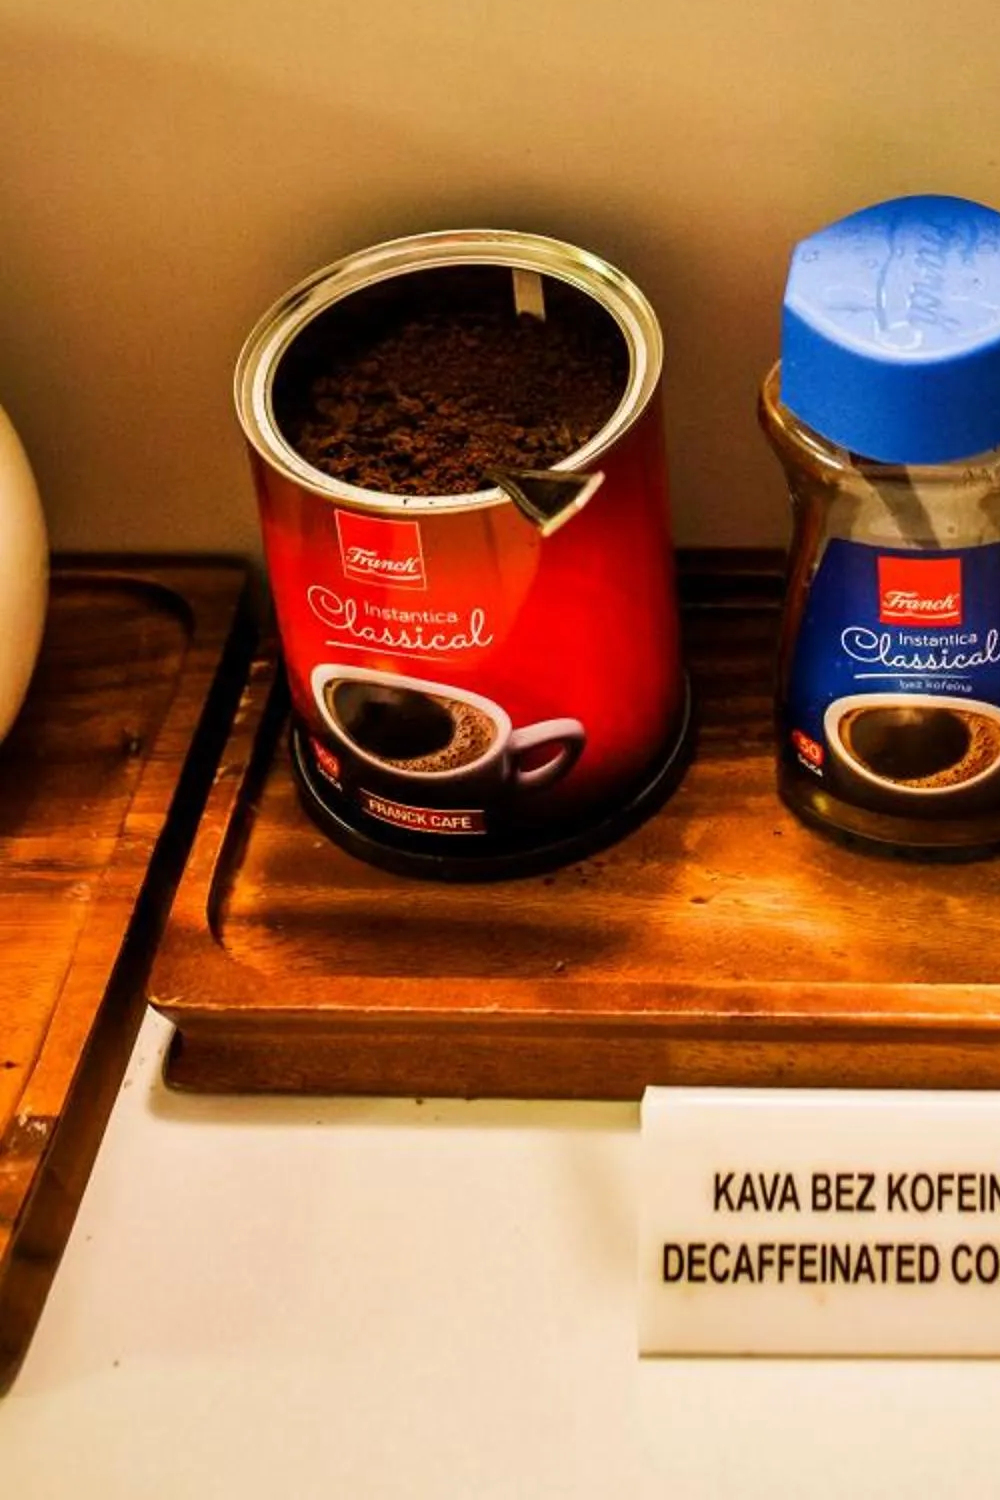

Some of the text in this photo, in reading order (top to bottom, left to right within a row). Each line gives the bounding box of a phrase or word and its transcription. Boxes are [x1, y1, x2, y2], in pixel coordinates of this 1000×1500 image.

[345, 547, 421, 573] Franck
[364, 601, 459, 624] Instantica
[883, 590, 960, 611] Franck
[307, 585, 494, 650] Classical
[899, 631, 978, 647] Instantica
[368, 799, 427, 825] FRANCK
[713, 1172, 801, 1212] KAVA
[811, 1172, 877, 1213] BEZ
[662, 1242, 941, 1285] DECAFFEINATED
